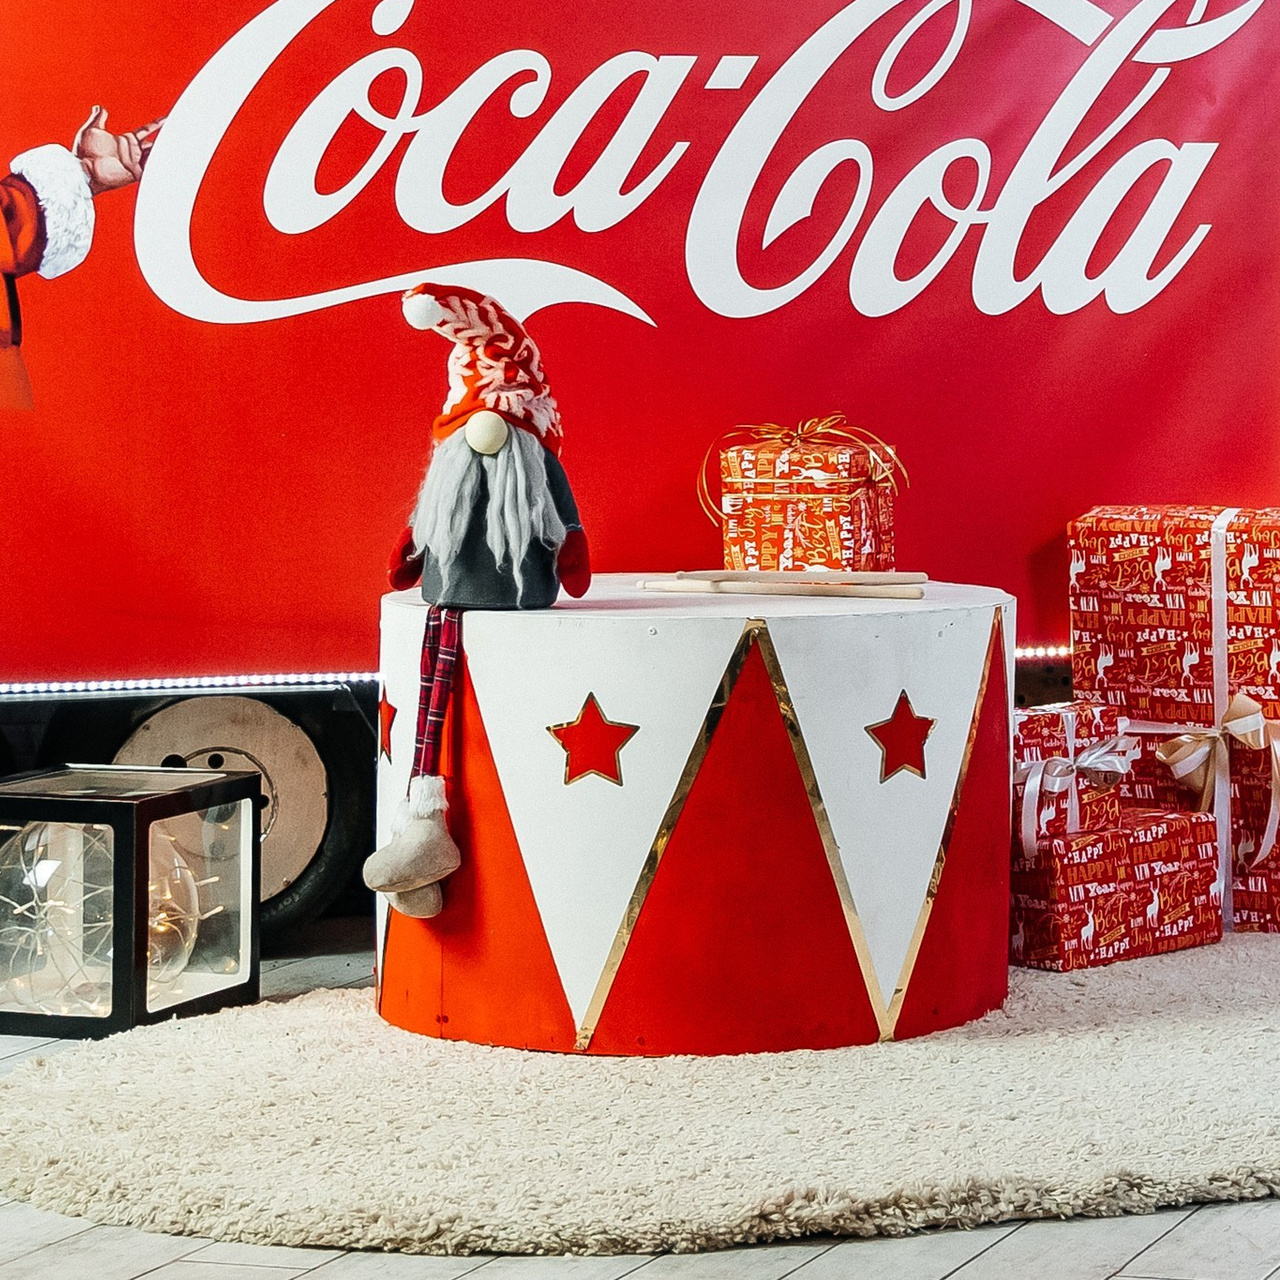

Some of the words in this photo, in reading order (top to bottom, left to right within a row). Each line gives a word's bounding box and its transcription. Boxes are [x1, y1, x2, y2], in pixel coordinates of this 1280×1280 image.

[737, 506, 765, 538] Joy
[800, 513, 829, 564] Best
[839, 515, 855, 560] HAPPY
[1079, 528, 1106, 554] Joy
[1109, 534, 1149, 548] HAPPY
[1165, 526, 1193, 551] Joy
[1251, 524, 1280, 549] Joy
[745, 540, 759, 571] APPY
[779, 529, 794, 571] Year
[1113, 560, 1155, 586] Best
[1125, 593, 1163, 607] Year
[1126, 609, 1185, 626] HAPPY
[1228, 606, 1272, 624] HAP
[1106, 622, 1134, 649] Joy
[1136, 628, 1176, 642] HAPPY
[1192, 620, 1211, 640] oy
[1142, 655, 1182, 680] Best
[1230, 651, 1269, 678] Best
[1153, 687, 1191, 702] Year
[1240, 685, 1278, 700] Year
[1154, 703, 1213, 720] HAPPY
[1081, 798, 1119, 829] Best
[1138, 823, 1168, 842] HAPPY
[1073, 843, 1103, 864] HAPPY
[1104, 833, 1126, 857] Joy
[1133, 839, 1178, 863] HAPPY
[1067, 859, 1113, 884] HAPPY
[1150, 861, 1180, 876] Year
[1085, 882, 1116, 897] Year
[1160, 877, 1188, 911] Best
[1094, 897, 1124, 932] Best
[1164, 915, 1194, 937] HAPPY
[1234, 910, 1259, 923] HAP
[1099, 937, 1130, 958] HAPPY
